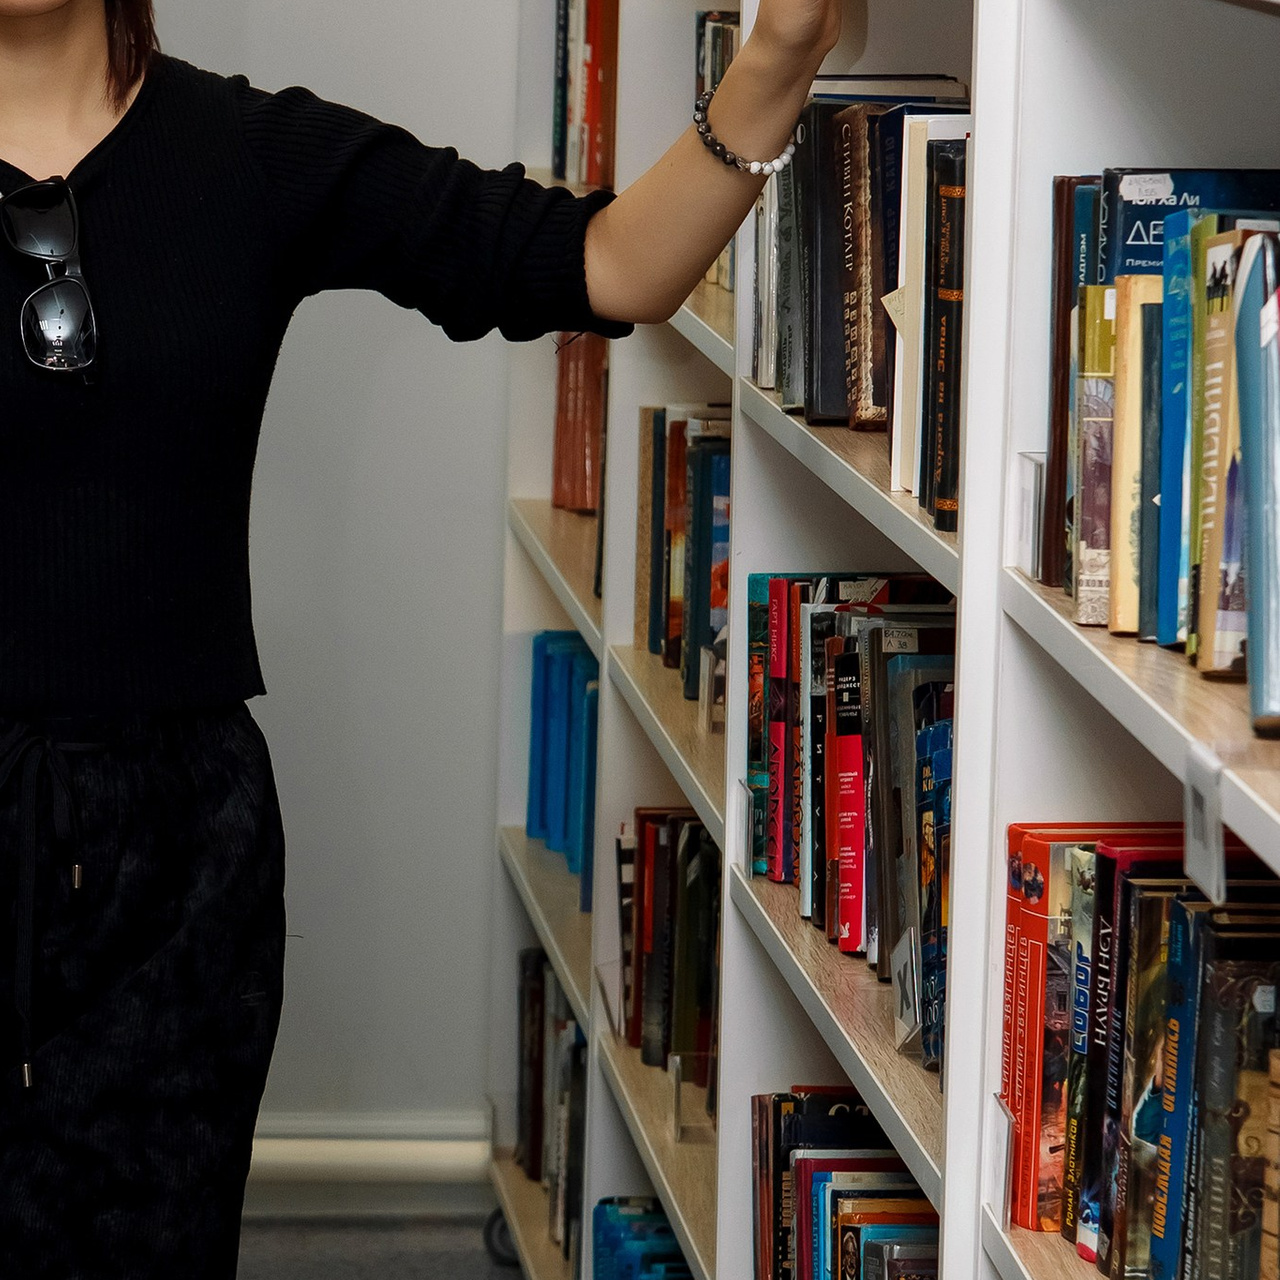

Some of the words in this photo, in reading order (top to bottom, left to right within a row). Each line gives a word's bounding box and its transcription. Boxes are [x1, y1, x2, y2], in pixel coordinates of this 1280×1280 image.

[1178, 192, 1201, 206] Ли
[937, 315, 947, 373] Запад
[937, 381, 944, 403] на
[934, 412, 945, 483] Дорога
[1004, 923, 1016, 1024] ЗВЯГИНЦЕВ
[1098, 915, 1113, 968] ДЭН
[1016, 937, 1029, 1038] ЗВЯГИНЦЕВ
[1072, 941, 1091, 1054] СОБОР
[1095, 975, 1110, 1047] БРАУН
[1066, 1118, 1078, 1183] ЗЛОТНИКОВ
[1065, 1188, 1074, 1227] РОМАН
